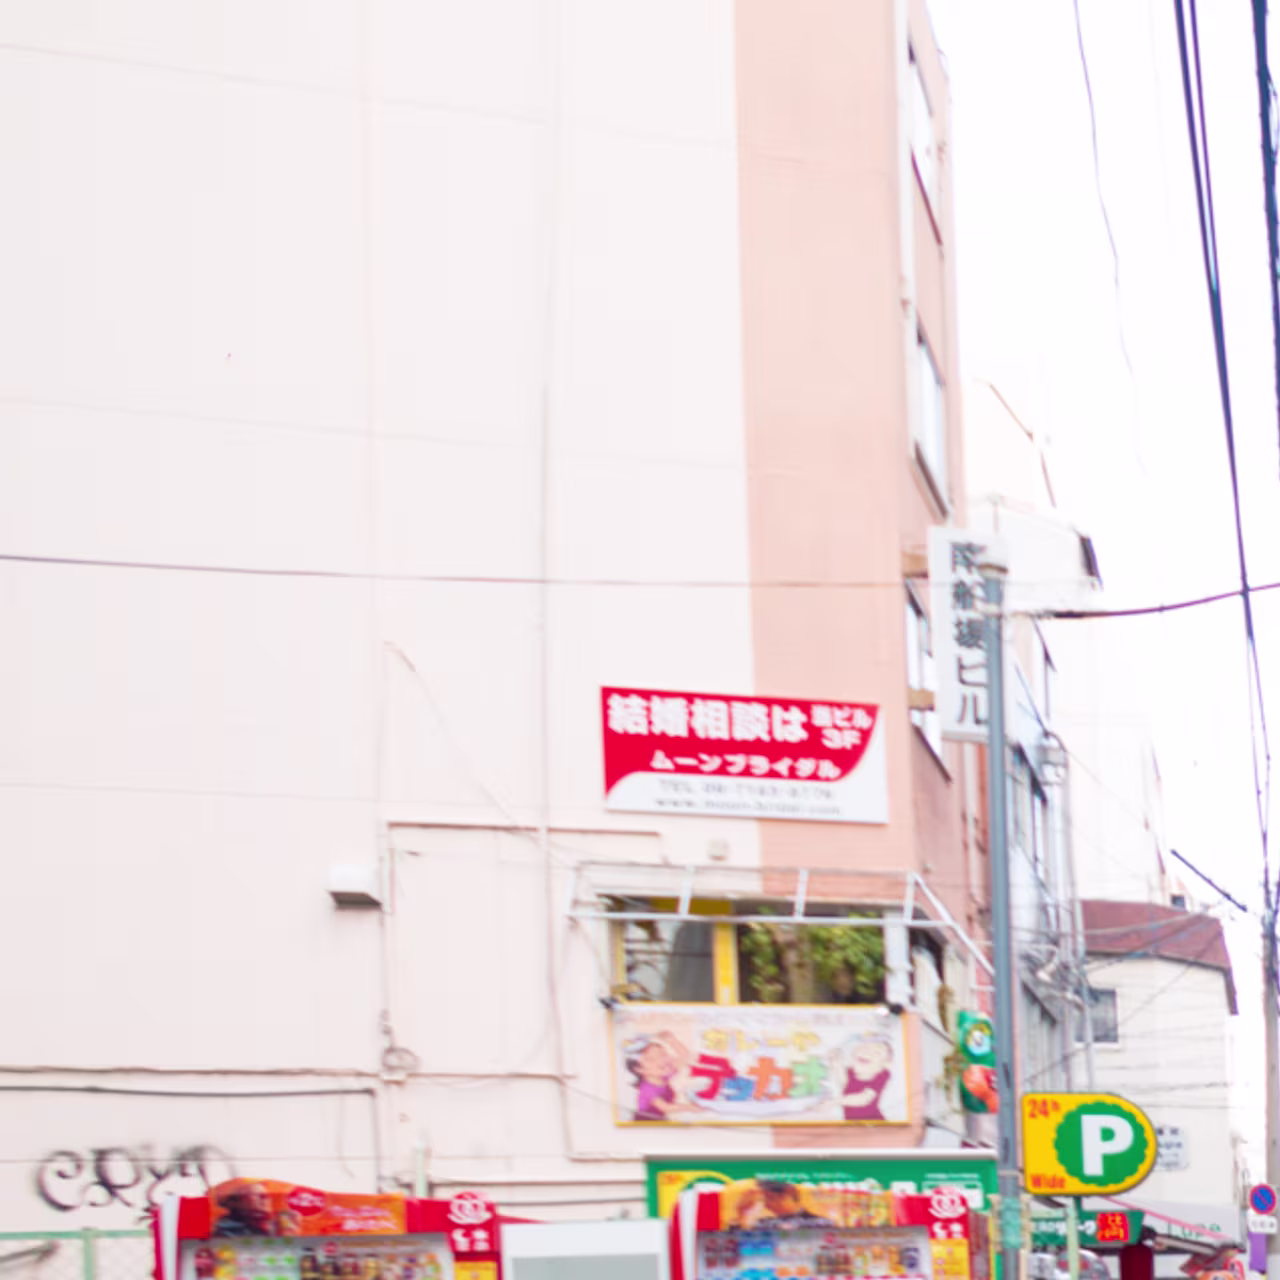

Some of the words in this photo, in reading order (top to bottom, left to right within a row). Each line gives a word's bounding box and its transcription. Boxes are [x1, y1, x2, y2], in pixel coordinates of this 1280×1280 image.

[607, 693, 808, 743] 結婚相談は
[1029, 1098, 1061, 1118] 24h
[1081, 1114, 1134, 1176] P
[1030, 1174, 1065, 1188] Wide
